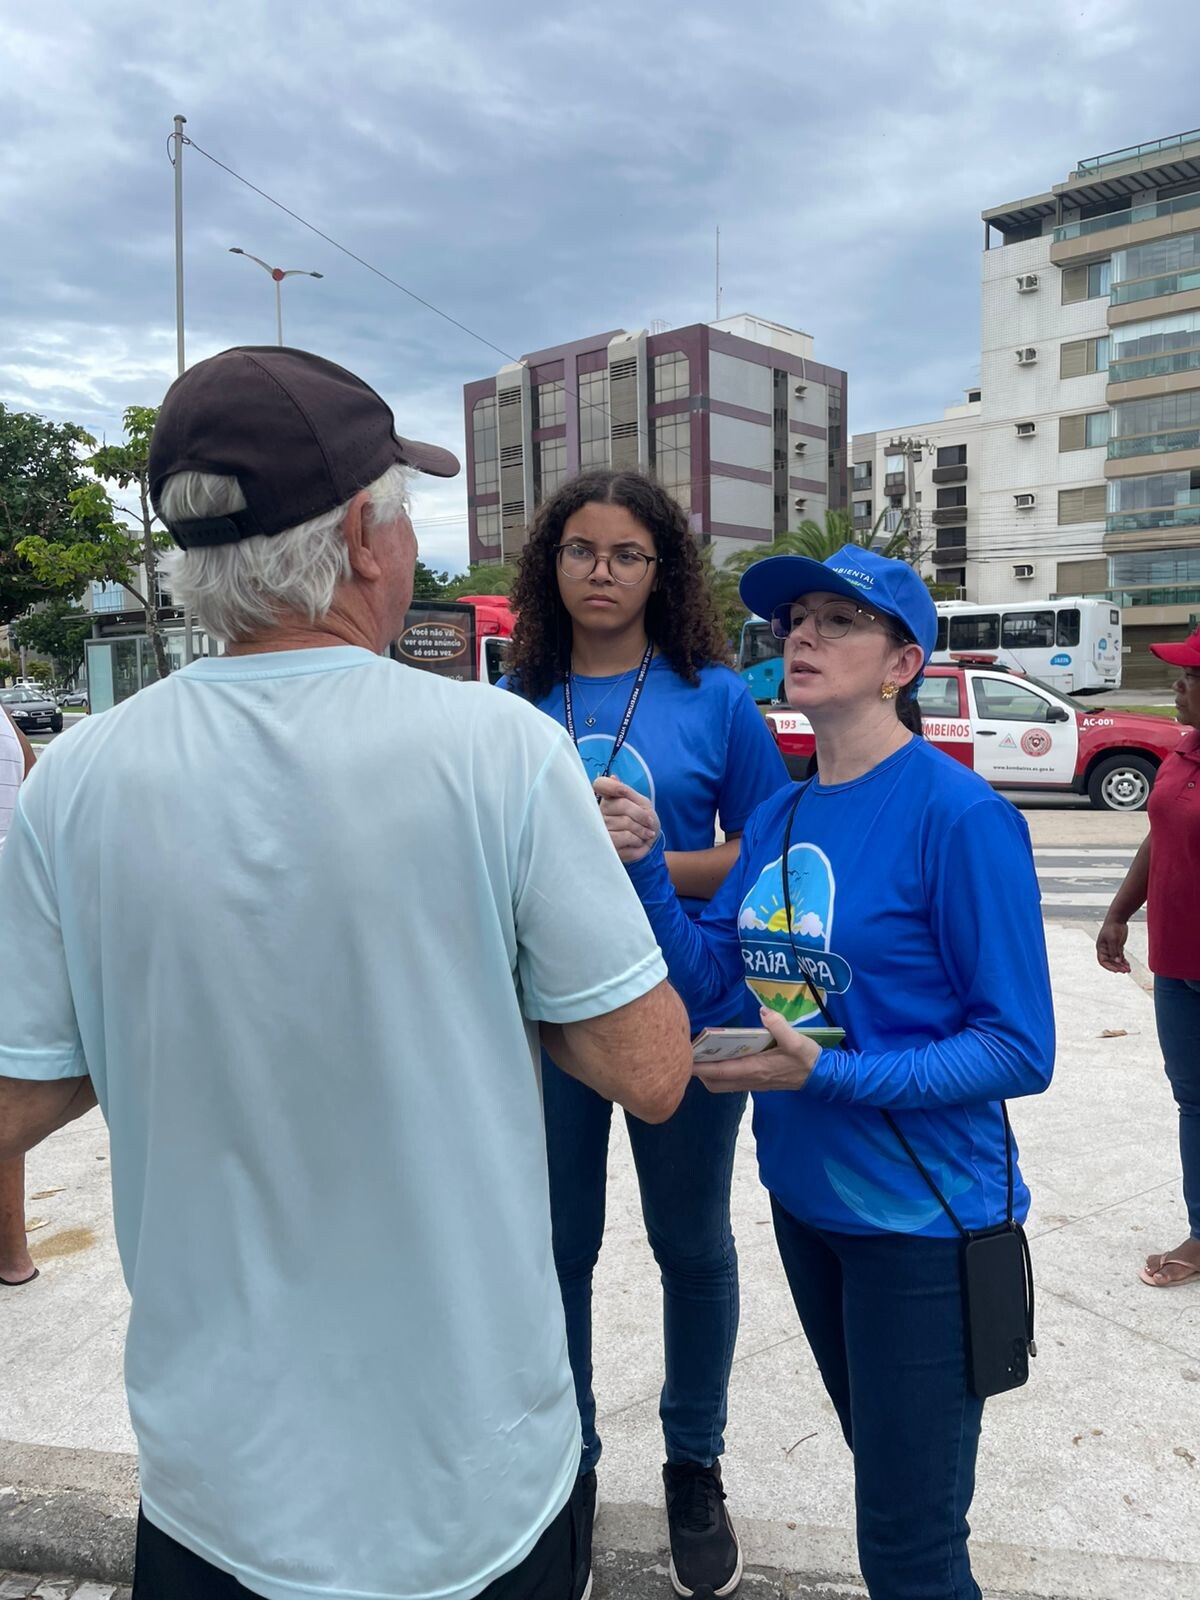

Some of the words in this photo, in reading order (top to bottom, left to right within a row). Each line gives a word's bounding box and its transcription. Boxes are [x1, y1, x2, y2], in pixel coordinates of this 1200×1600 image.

[832, 567, 874, 585] MBIENTAL
[411, 628, 428, 636] Você
[430, 629, 443, 637] não
[434, 639, 461, 647] anúncio
[413, 648, 423, 656] só
[779, 719, 796, 729] 193
[1083, 718, 1114, 726] AC-001
[922, 723, 970, 737] MBEIROS
